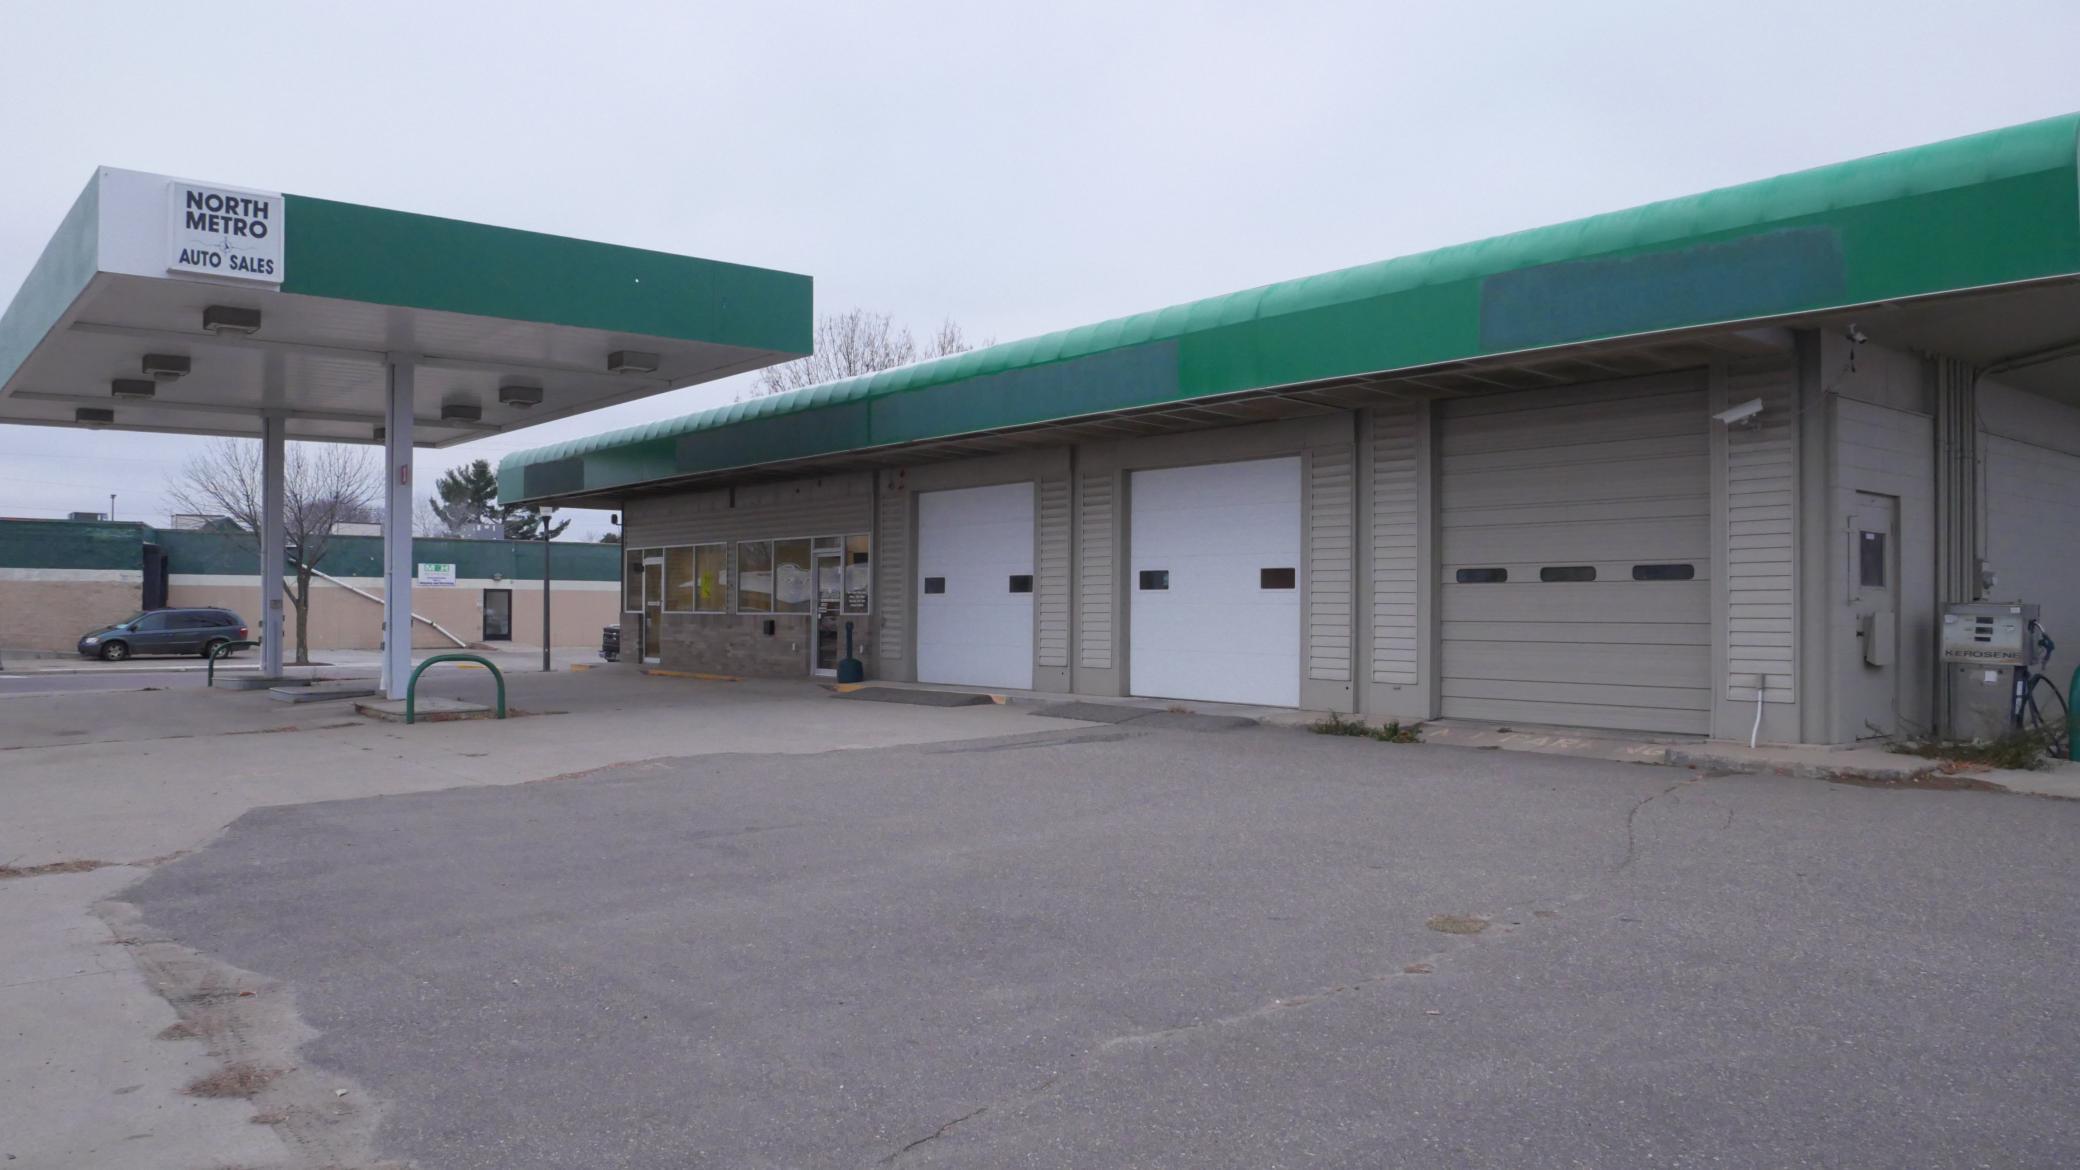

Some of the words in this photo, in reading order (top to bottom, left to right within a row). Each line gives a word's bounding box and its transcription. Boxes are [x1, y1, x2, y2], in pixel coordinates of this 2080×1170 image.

[186, 190, 269, 220] NORTH
[186, 210, 268, 239] METRO
[179, 248, 222, 268] AUTO
[229, 254, 274, 275] SALES
[1945, 650, 2021, 659] KEROSENE
